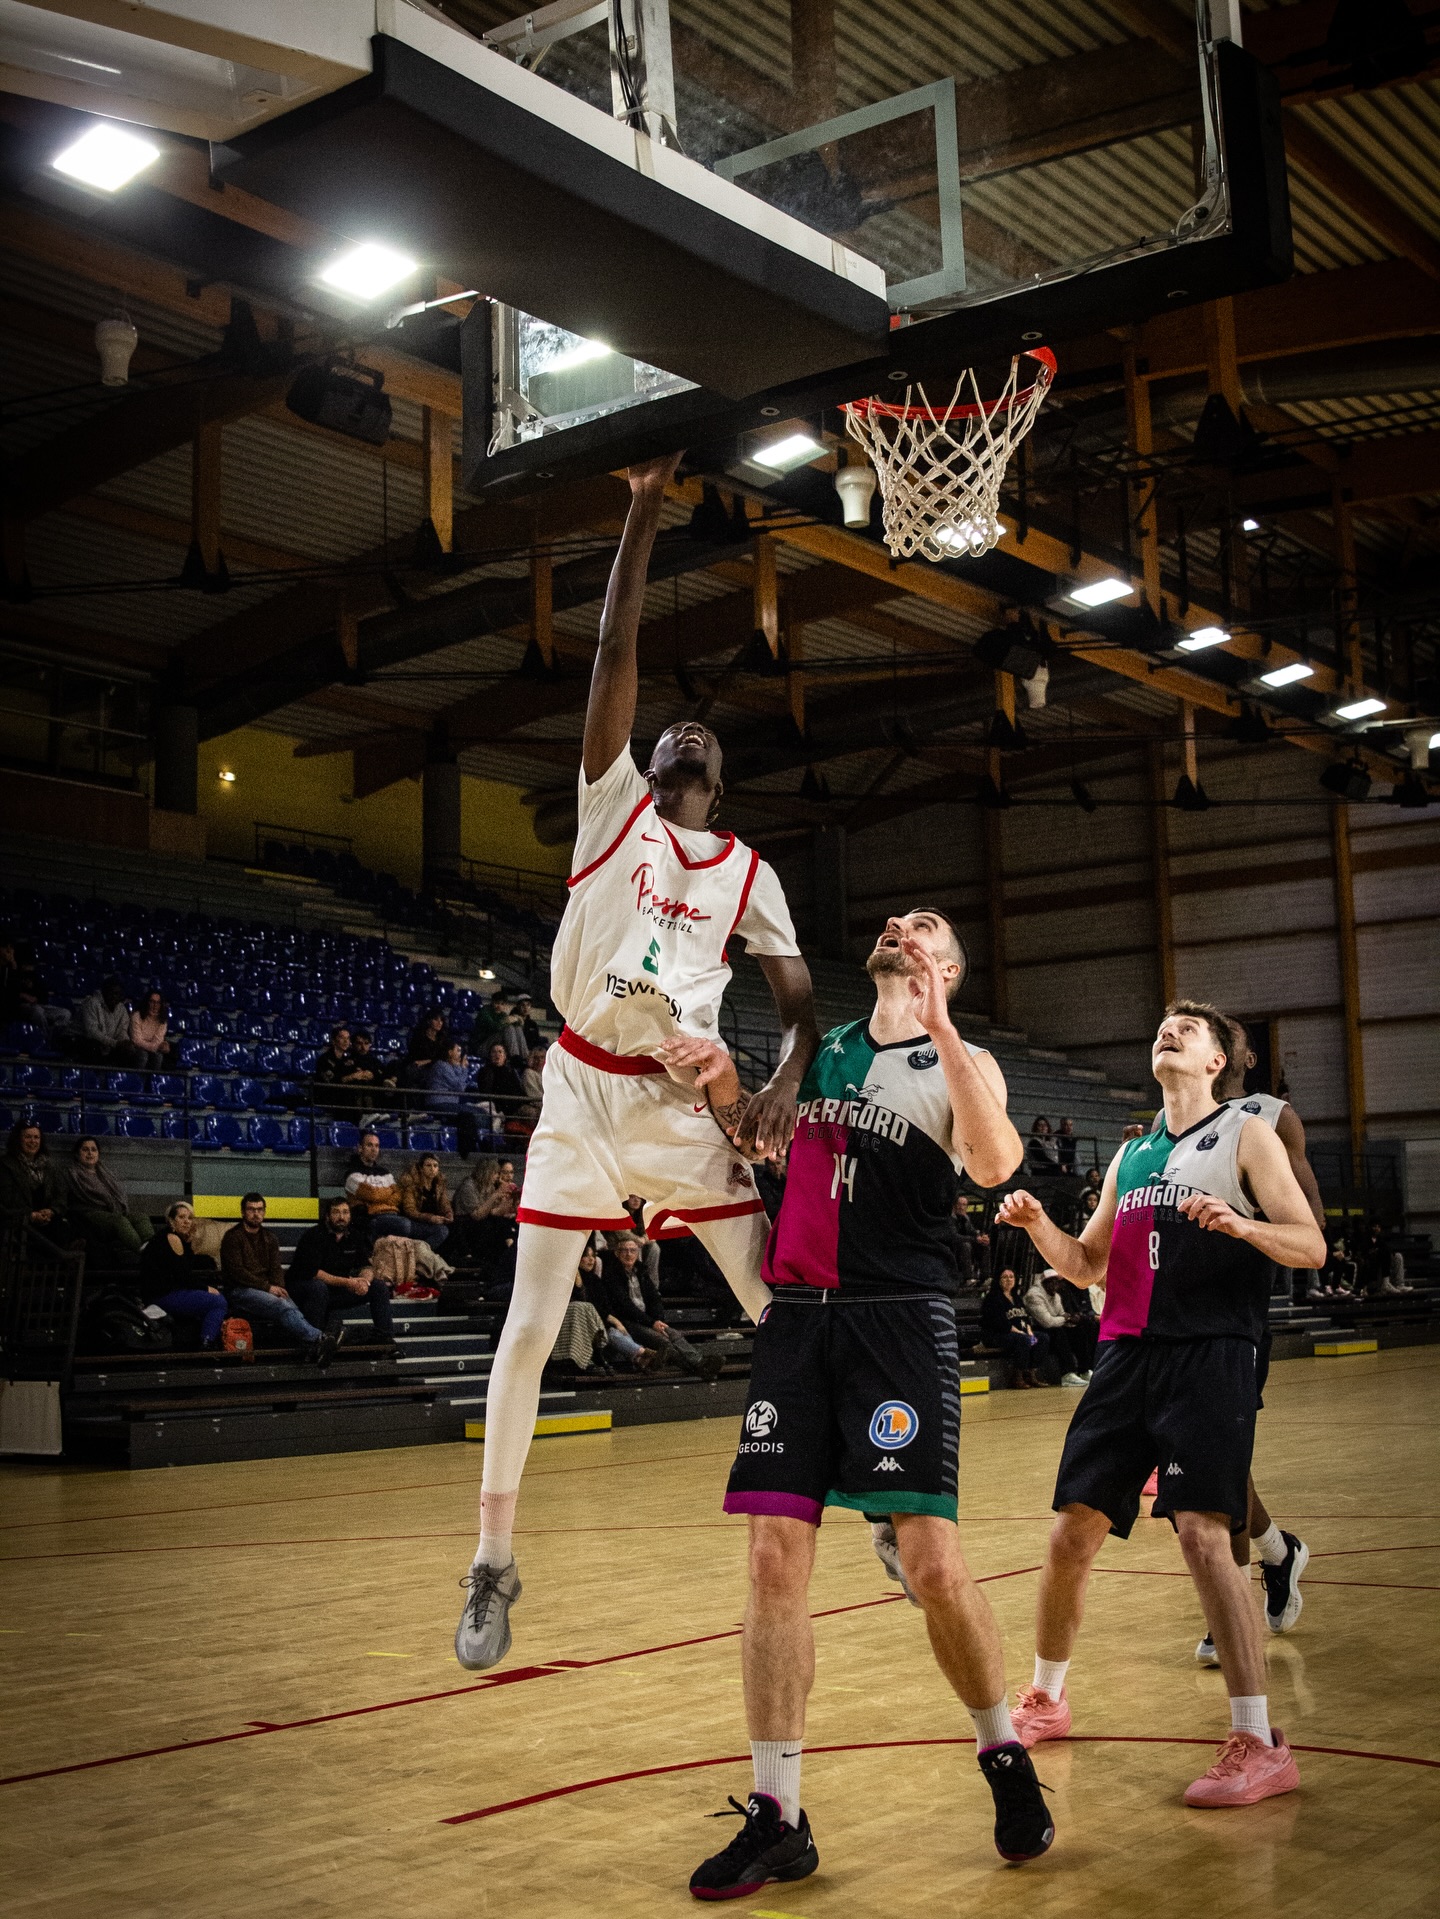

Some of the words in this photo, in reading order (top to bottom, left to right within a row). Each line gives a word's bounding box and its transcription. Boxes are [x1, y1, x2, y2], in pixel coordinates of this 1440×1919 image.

[830, 1152, 858, 1203] 14
[1115, 1184, 1205, 1220] PERIGOR
[1148, 1231, 1160, 1270] 8
[738, 1442, 784, 1454] GEODIS
